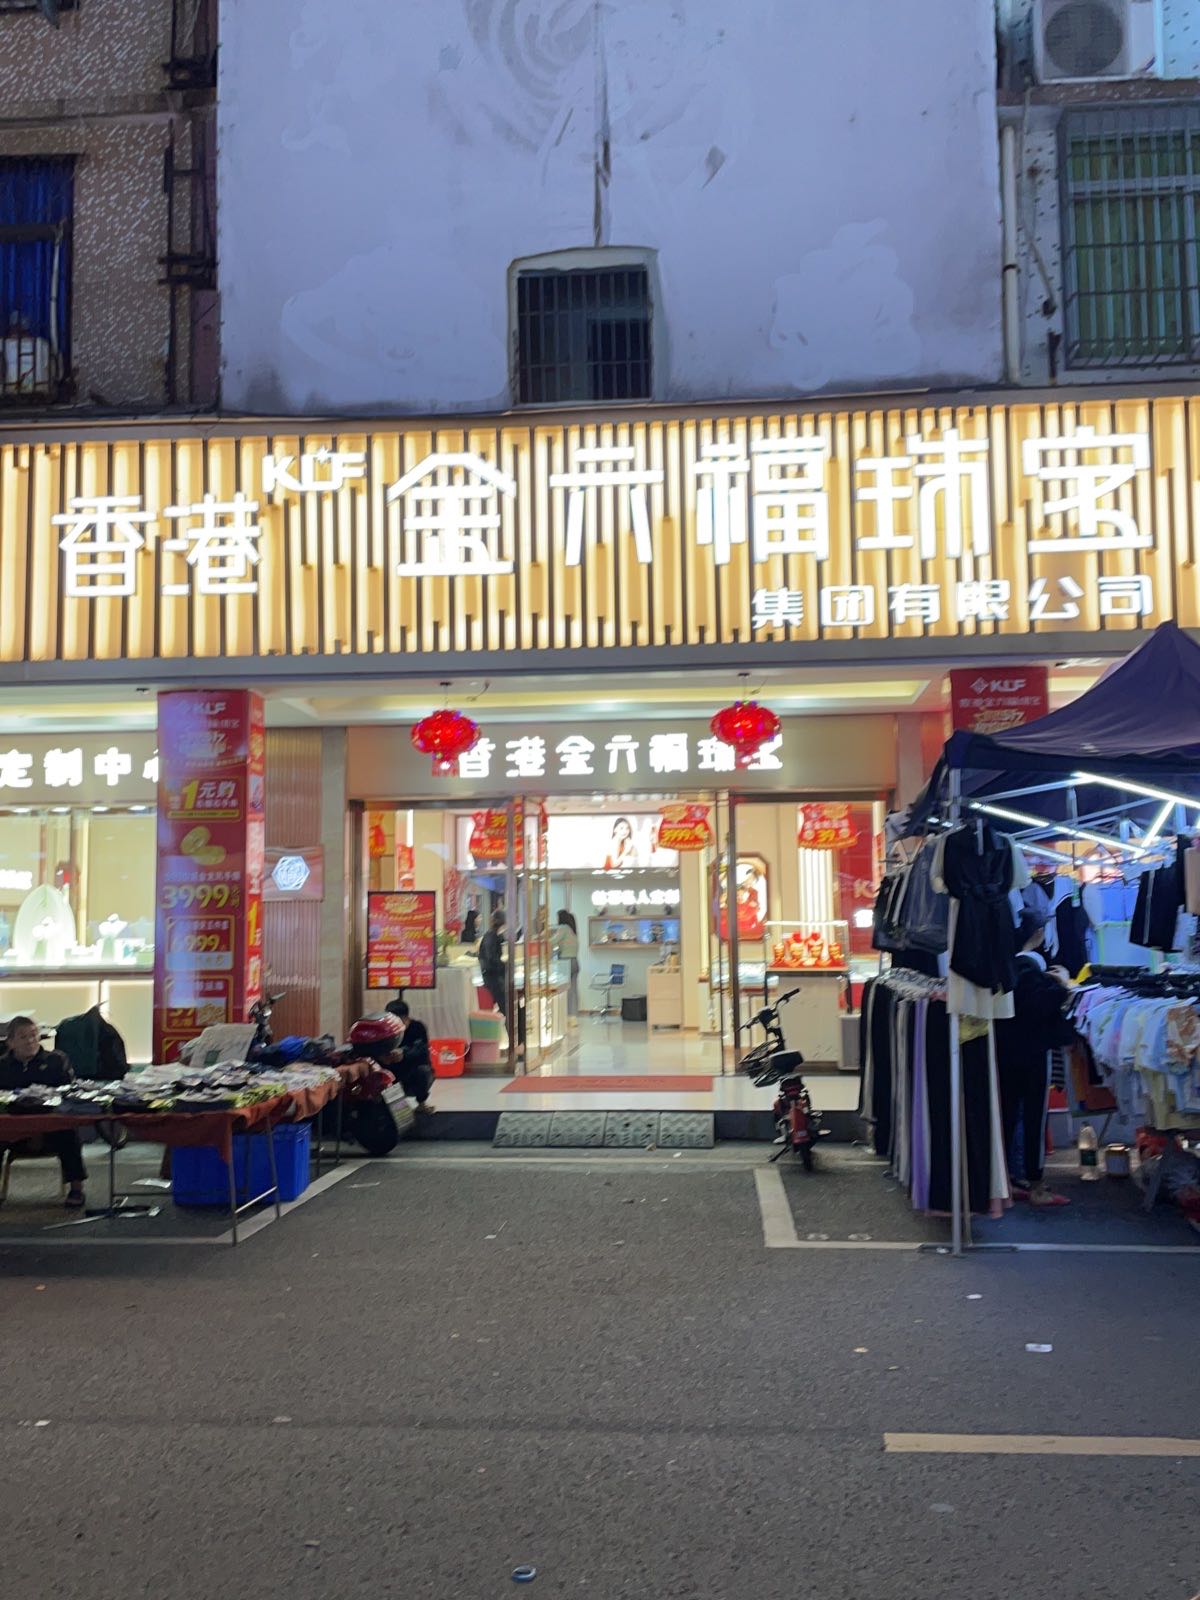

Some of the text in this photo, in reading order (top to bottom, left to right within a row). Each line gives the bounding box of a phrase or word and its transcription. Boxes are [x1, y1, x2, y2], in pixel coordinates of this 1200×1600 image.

[51, 492, 261, 597] 香港
[387, 425, 1153, 578] 金六福珠宝
[751, 573, 1153, 629] 集团有限公司
